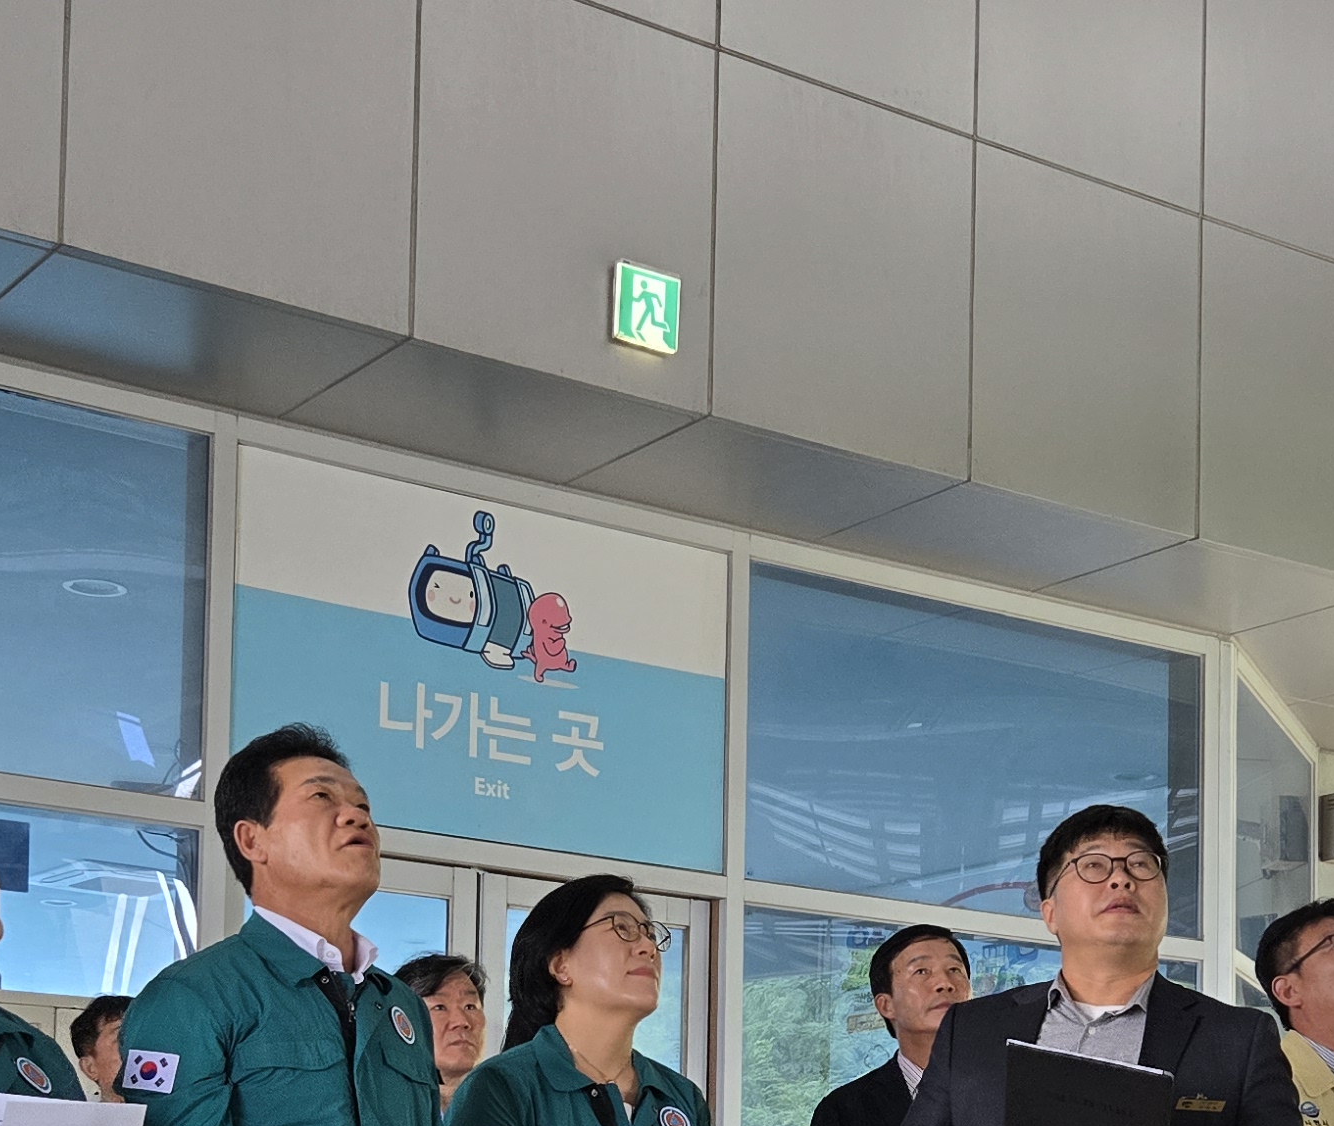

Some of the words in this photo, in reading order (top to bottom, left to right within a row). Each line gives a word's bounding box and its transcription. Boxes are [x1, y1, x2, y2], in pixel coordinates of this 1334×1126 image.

[379, 681, 537, 766] 나가는
[551, 710, 605, 778] 곳
[473, 777, 510, 800] Exit
